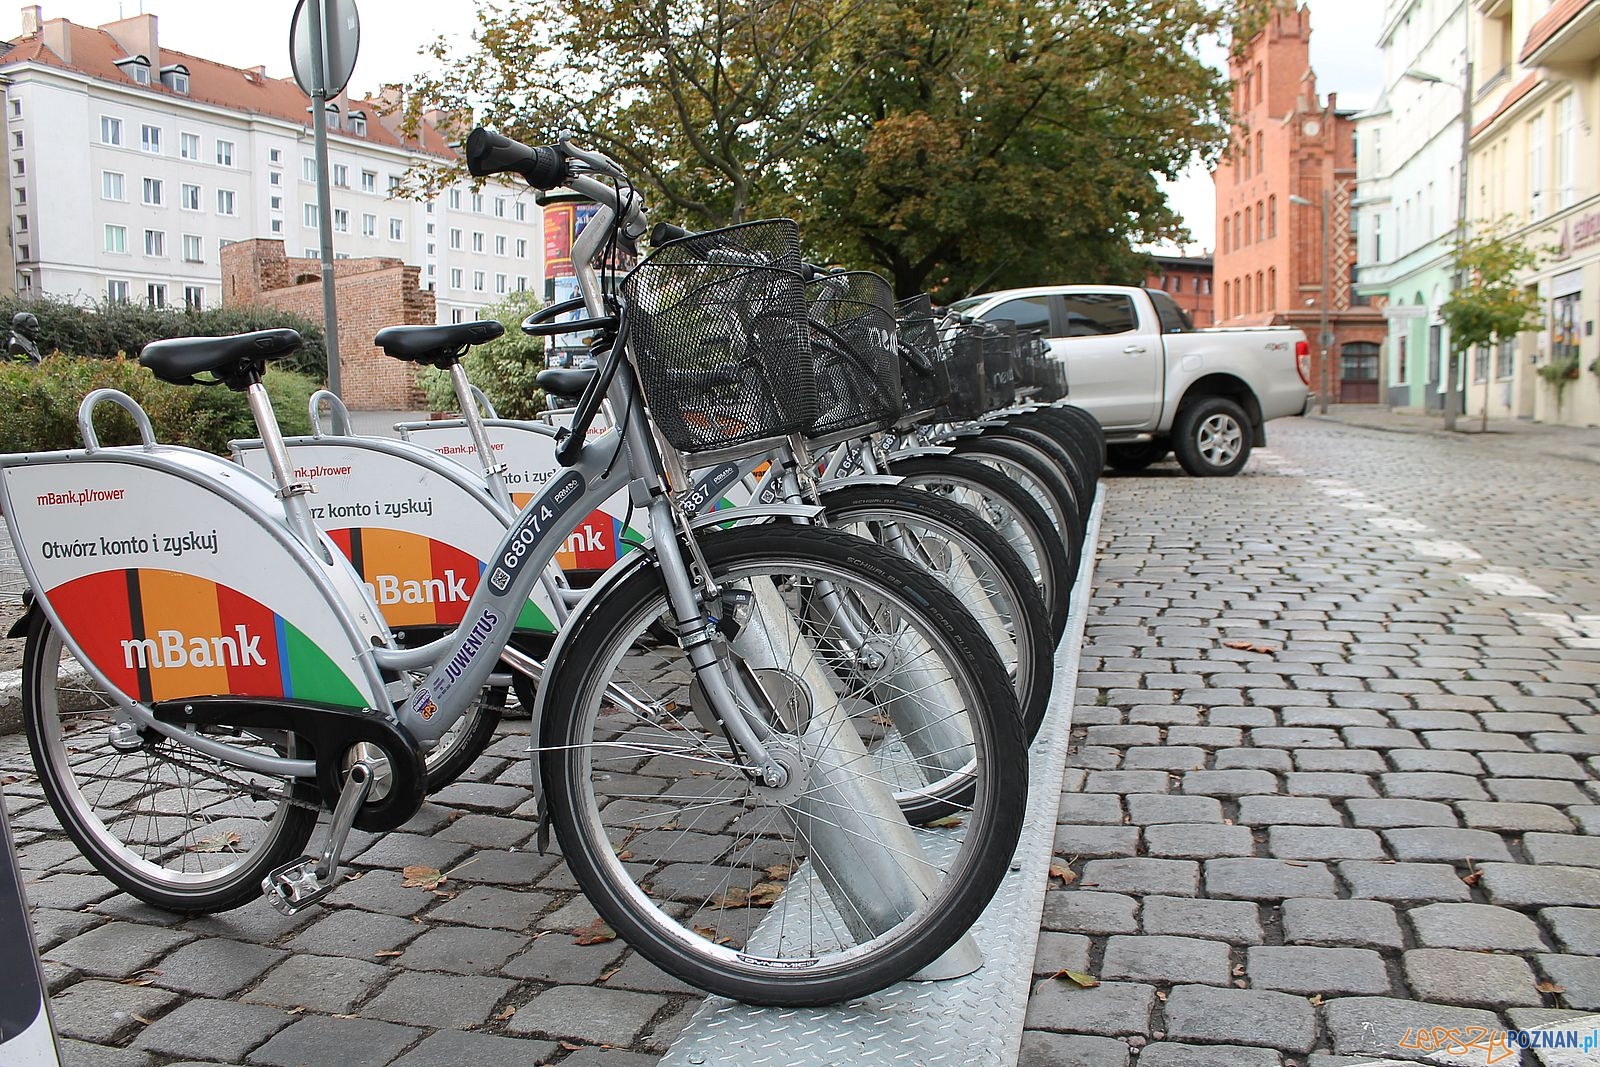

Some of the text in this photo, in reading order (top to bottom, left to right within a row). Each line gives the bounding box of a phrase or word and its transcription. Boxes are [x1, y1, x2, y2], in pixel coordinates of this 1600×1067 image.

[272, 466, 352, 480] nk.pl/rower
[524, 471, 529, 482] i
[37, 488, 125, 506] mBank.pl/rower
[328, 502, 371, 518] konto
[375, 500, 381, 515] i
[384, 497, 433, 518] zyskuj
[41, 529, 219, 559] Otwórz konto i zyskuj
[504, 504, 553, 568] 68074
[121, 624, 267, 669] mBank
[444, 608, 499, 684] JUWENTUS
[421, 702, 438, 720] GPS
